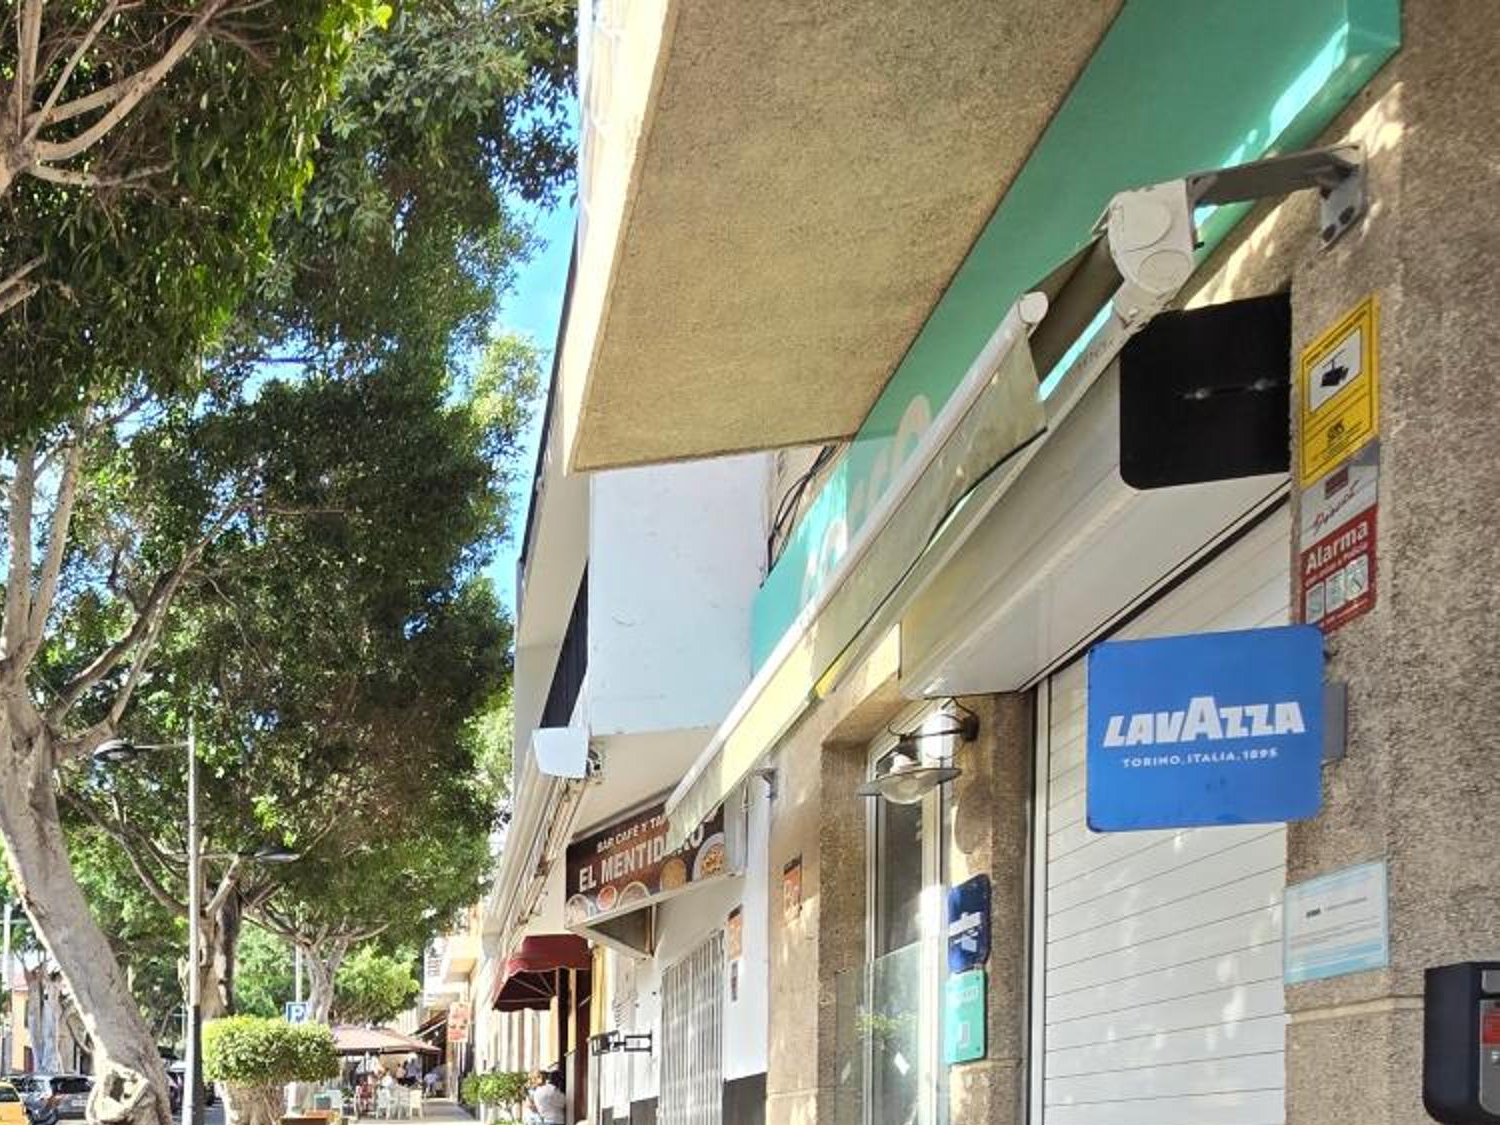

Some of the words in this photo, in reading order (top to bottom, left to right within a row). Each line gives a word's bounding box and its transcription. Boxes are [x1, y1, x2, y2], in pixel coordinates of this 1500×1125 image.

[1304, 521, 1369, 576] Alarma
[1103, 696, 1306, 748] LAVAZZA
[579, 864, 597, 893] EL
[601, 823, 705, 885] MENTIDO
[597, 836, 615, 853] BAR
